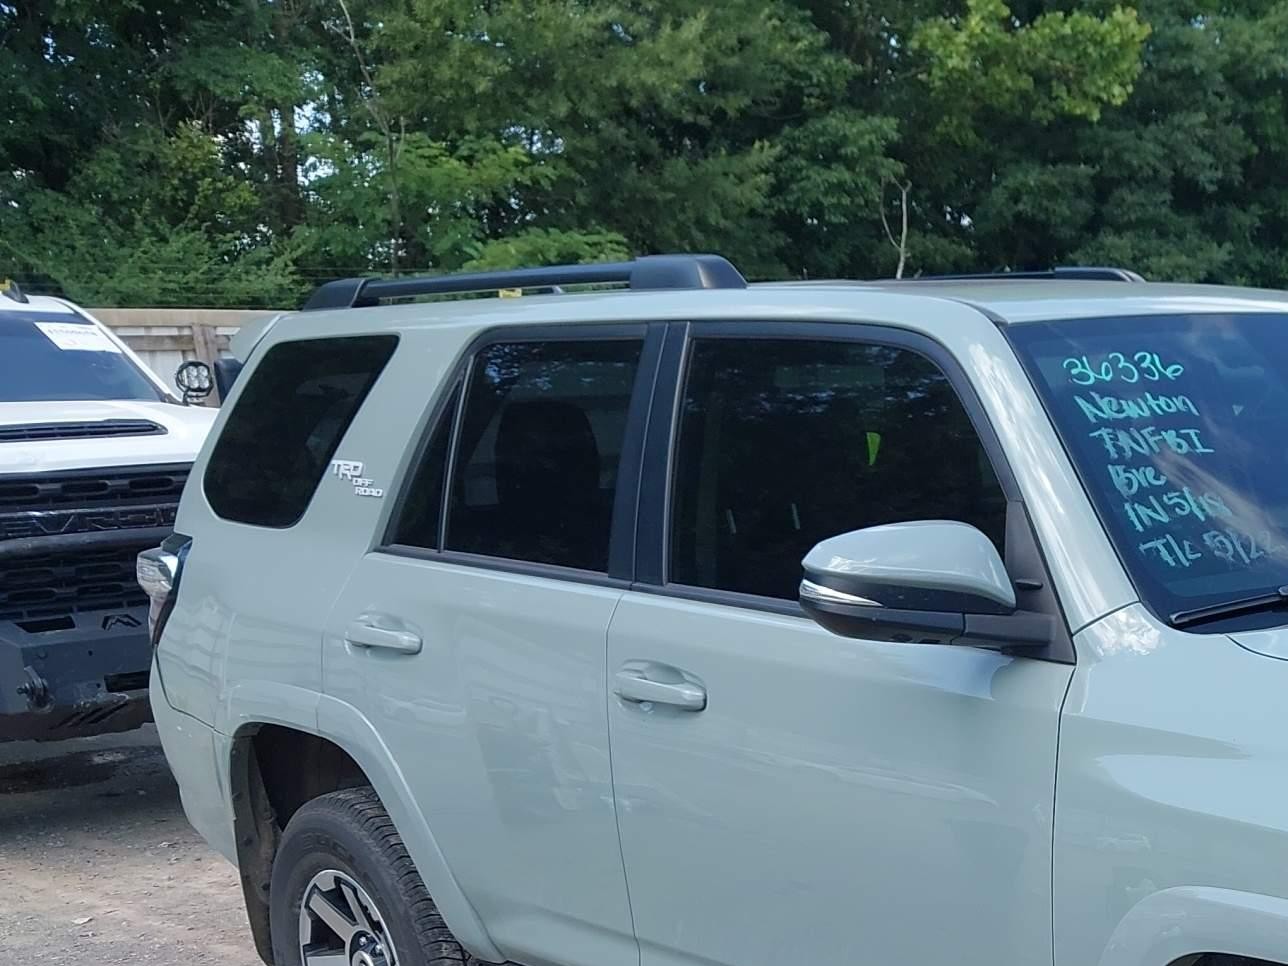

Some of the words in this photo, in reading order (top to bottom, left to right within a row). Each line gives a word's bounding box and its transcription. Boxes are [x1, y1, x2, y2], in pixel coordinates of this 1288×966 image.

[1062, 351, 1184, 385] 36336
[331, 459, 363, 480] TRD
[352, 477, 374, 487] OFF
[354, 486, 383, 497] ROAD
